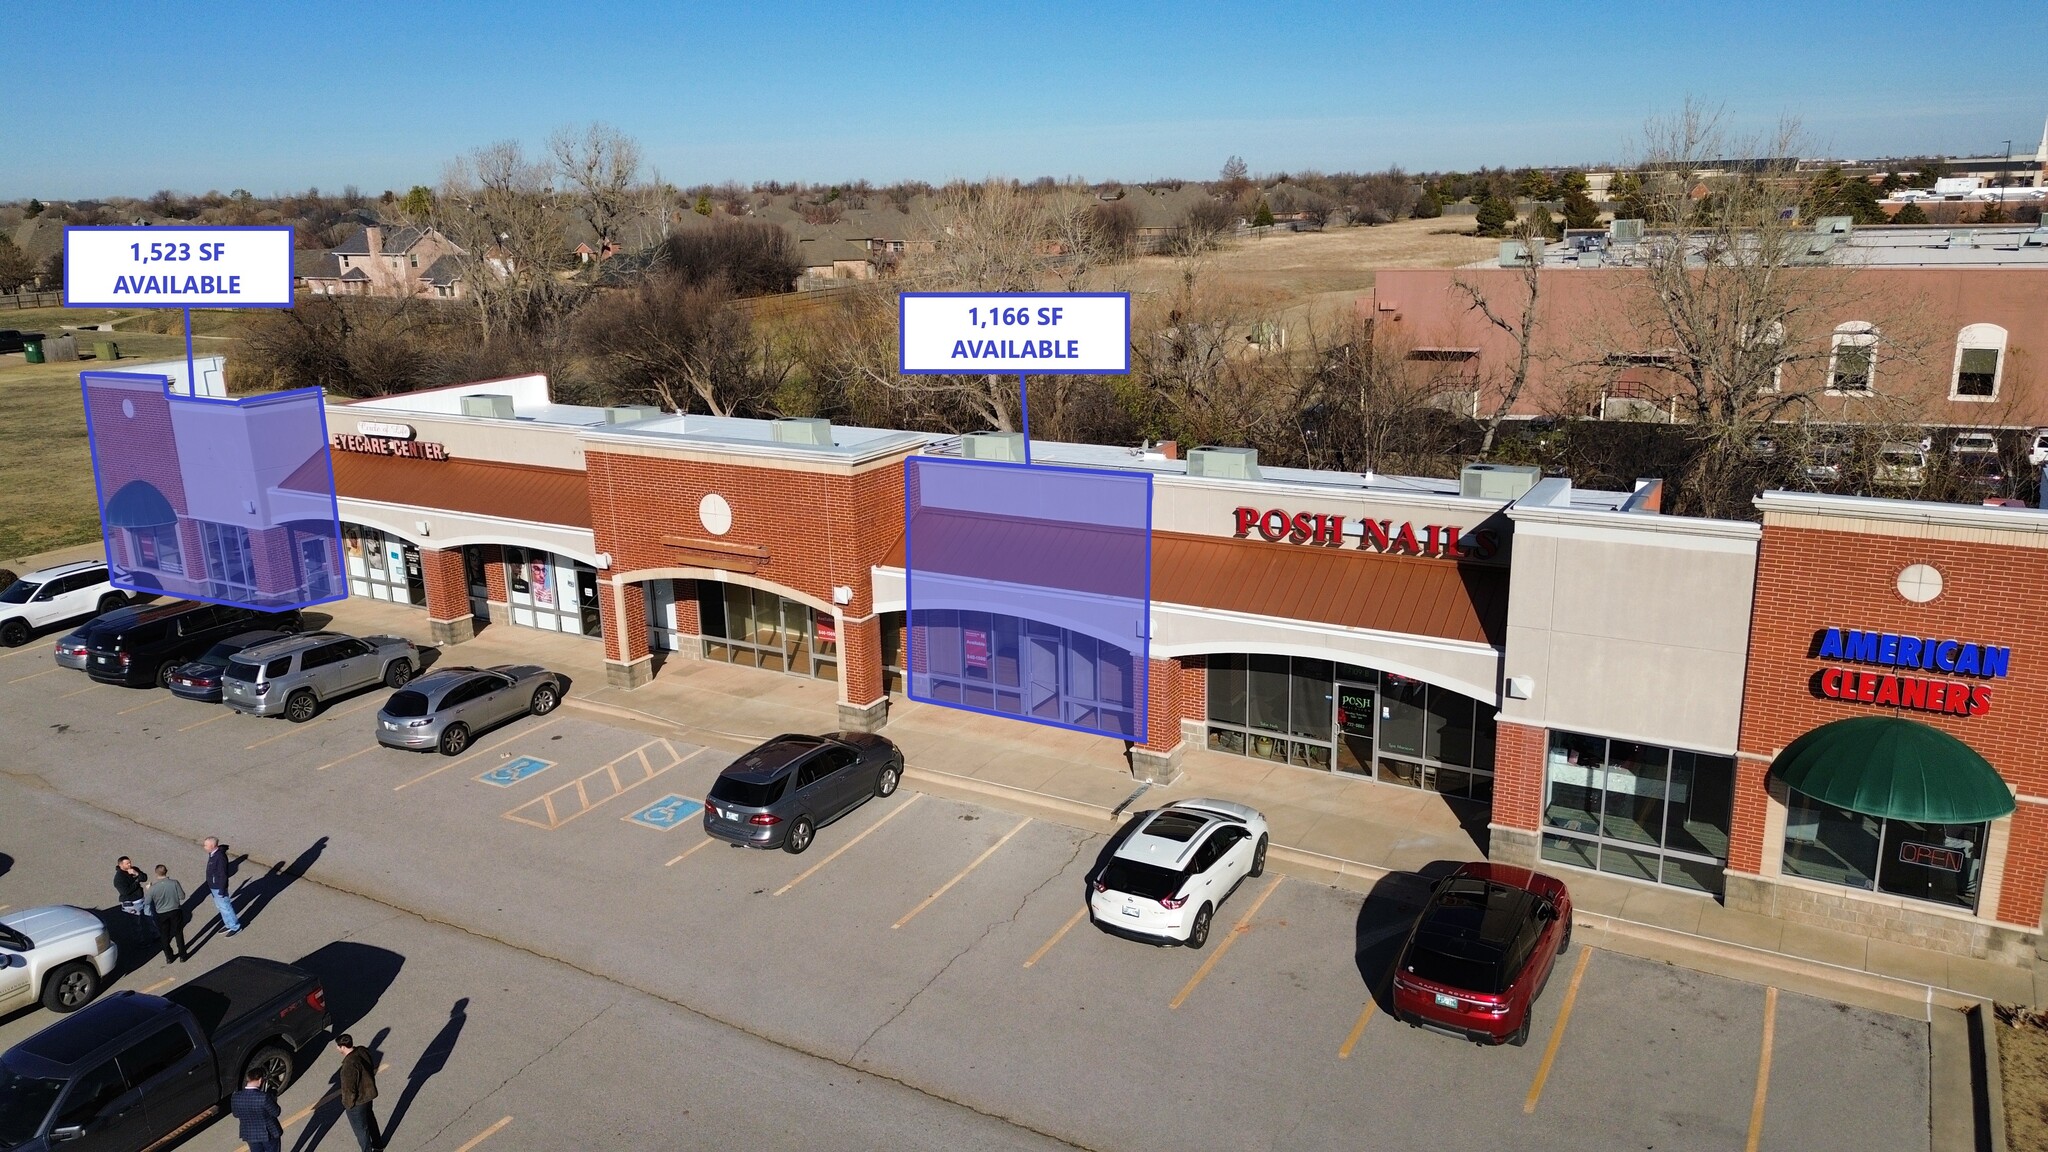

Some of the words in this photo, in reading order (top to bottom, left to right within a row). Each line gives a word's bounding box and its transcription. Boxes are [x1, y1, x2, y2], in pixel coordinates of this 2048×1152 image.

[333, 433, 388, 454] EYECARE
[393, 440, 443, 460] CENTER
[1237, 506, 1345, 545] POSH
[1361, 516, 1498, 560] NAILS
[1819, 627, 2011, 679] AMERICAN
[1342, 695, 1371, 709] POSH
[1821, 667, 1992, 716] CLEANERS
[1902, 845, 1961, 871] OPEN
[1418, 982, 1444, 992] RANGE
[1447, 990, 1477, 1000] ROVER
